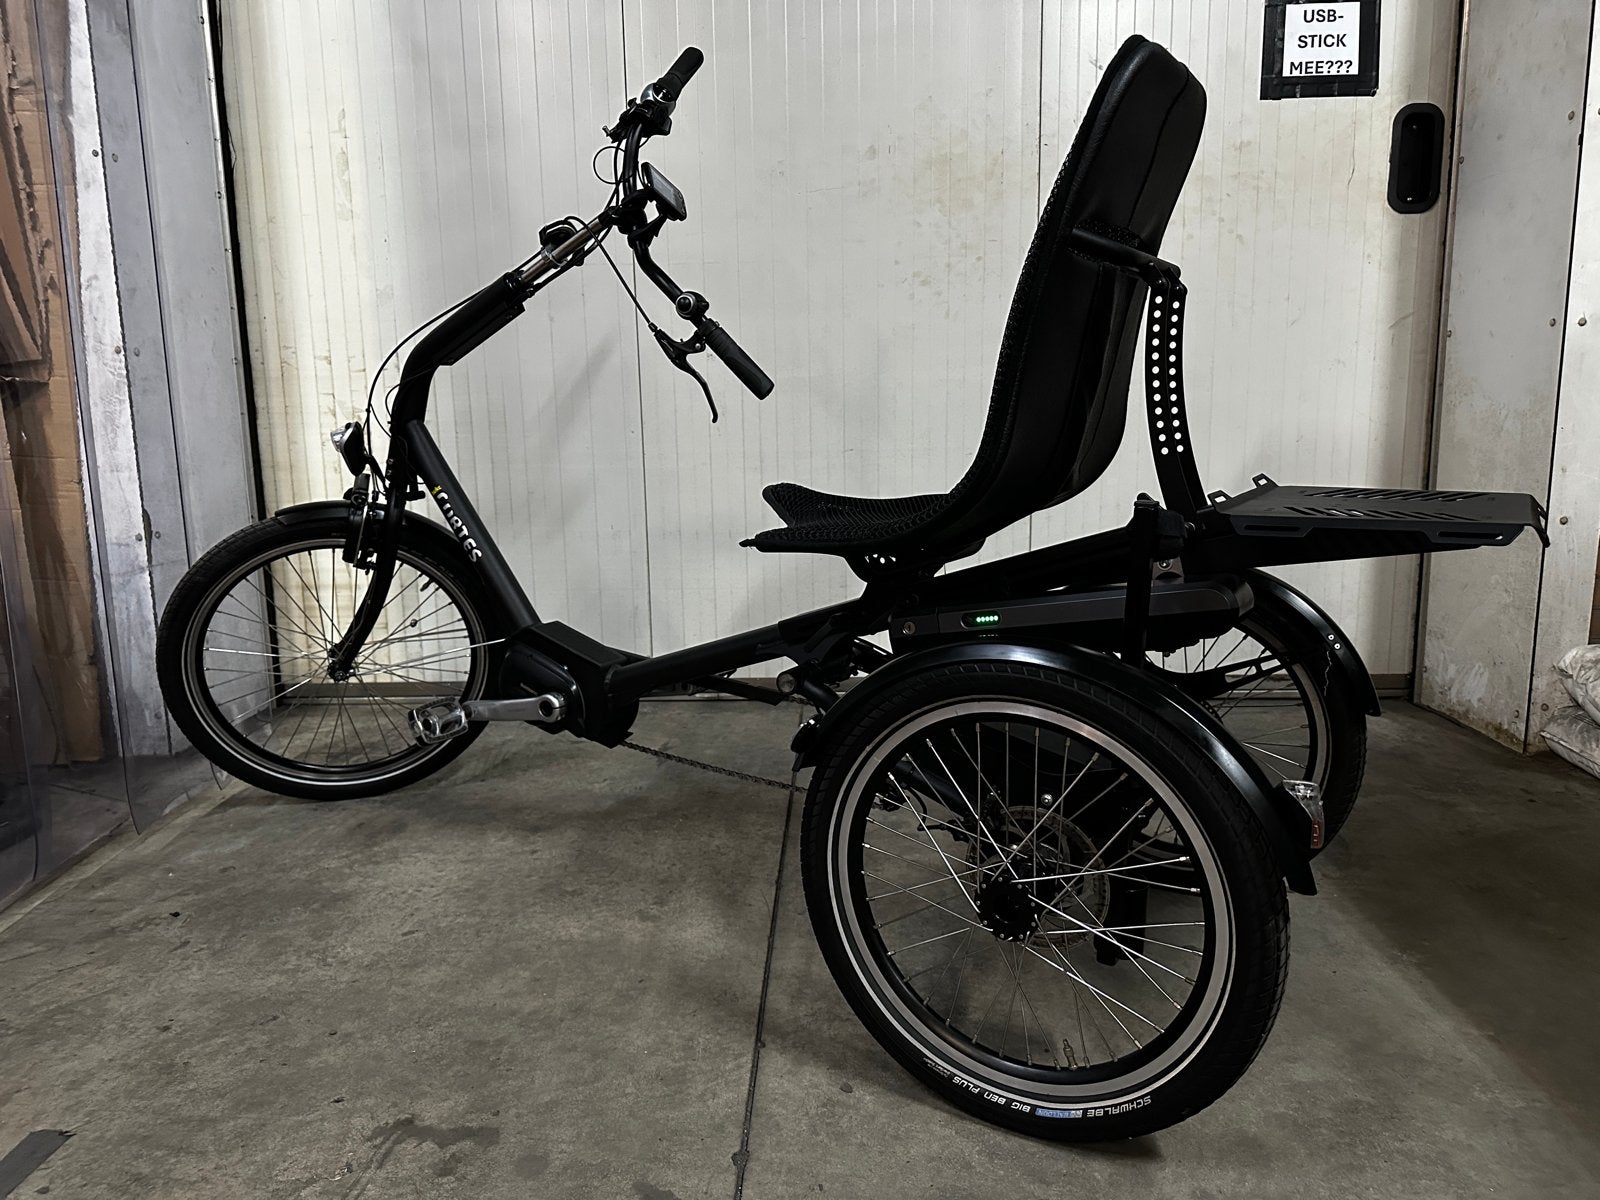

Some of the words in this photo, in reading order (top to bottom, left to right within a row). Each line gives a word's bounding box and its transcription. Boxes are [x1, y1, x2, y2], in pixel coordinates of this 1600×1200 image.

[1303, 9, 1344, 23] USB-
[1297, 33, 1347, 48] STICK
[1289, 60, 1353, 75] MEE???
[952, 1076, 981, 1094] PLUS
[983, 1091, 1007, 1105] BEN
[1010, 1102, 1031, 1113] BIG
[1086, 1096, 1152, 1117] SCHWALBE
